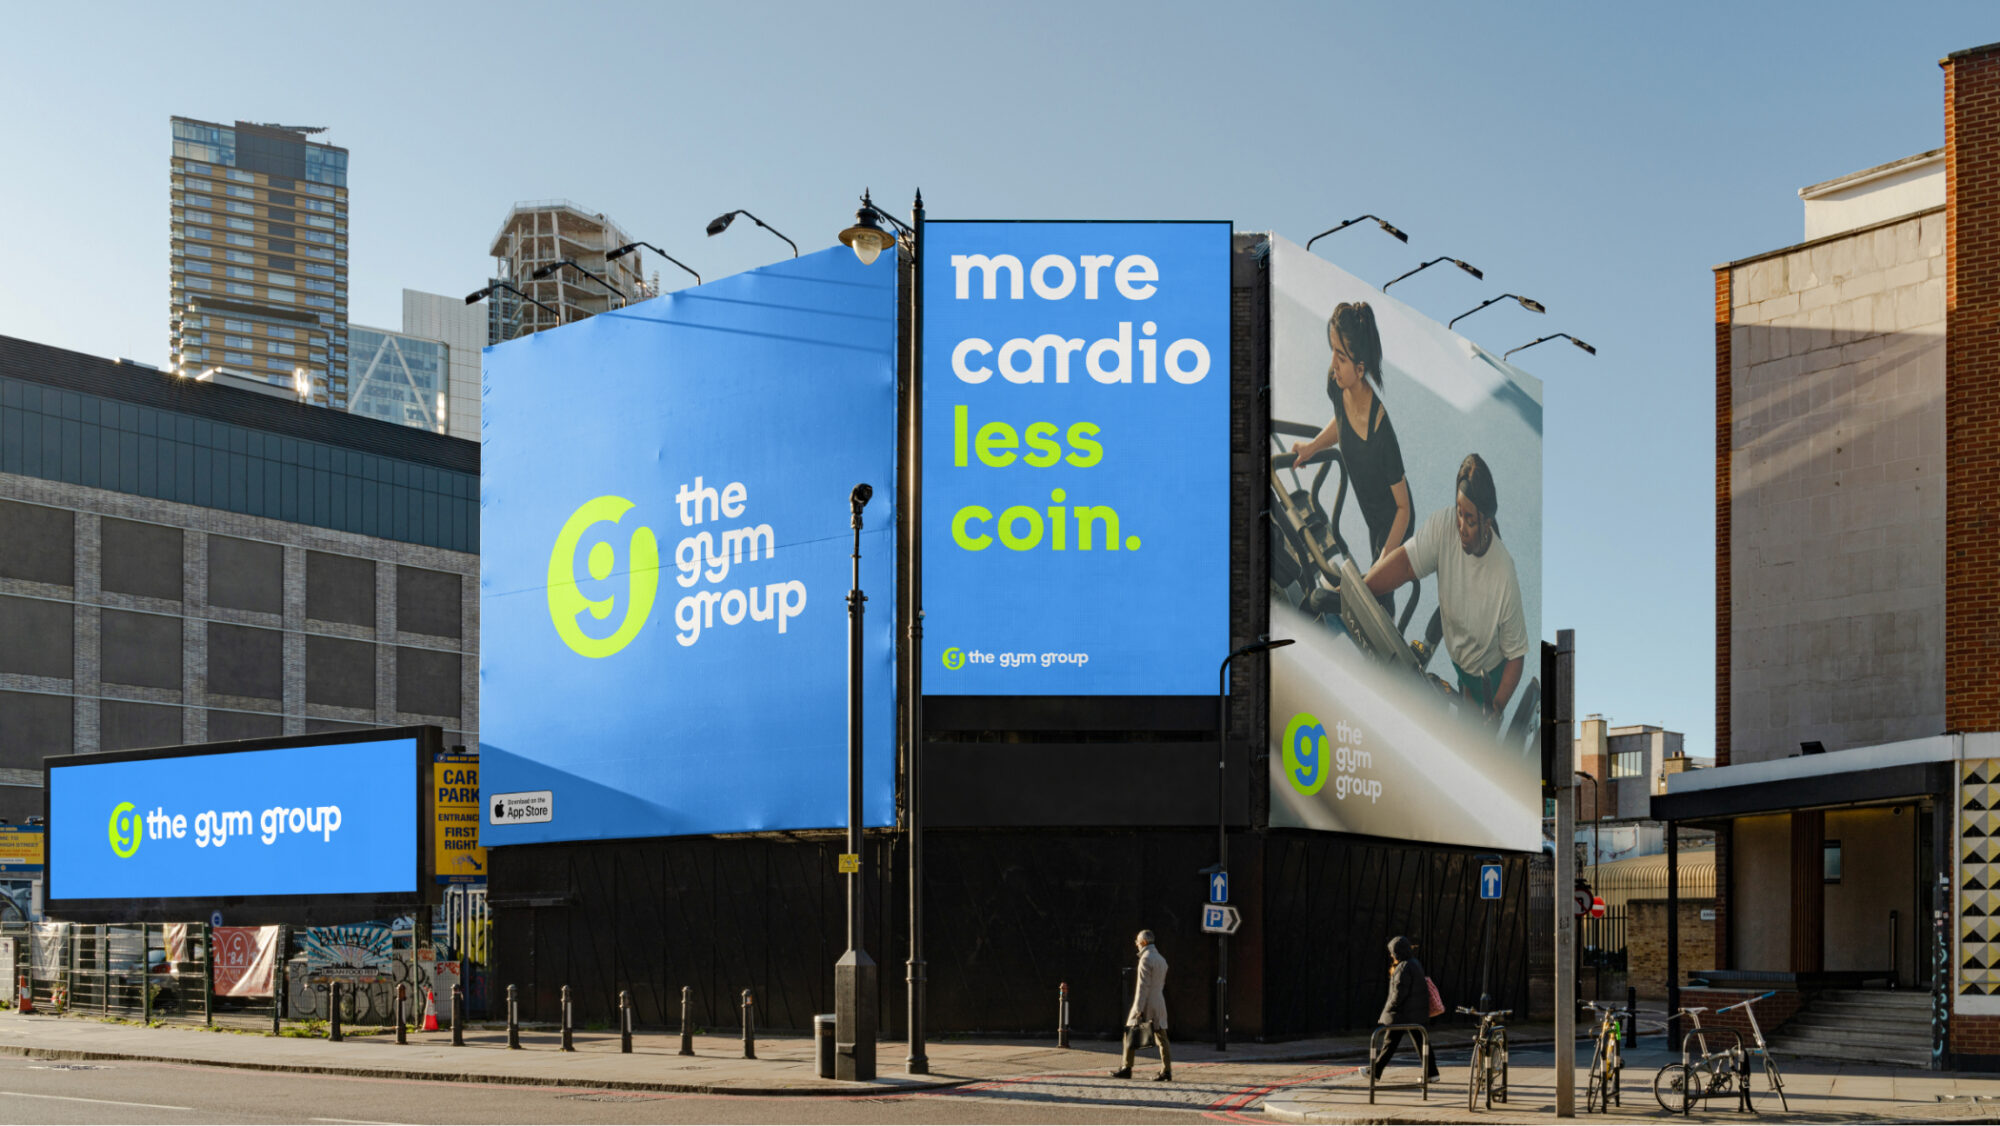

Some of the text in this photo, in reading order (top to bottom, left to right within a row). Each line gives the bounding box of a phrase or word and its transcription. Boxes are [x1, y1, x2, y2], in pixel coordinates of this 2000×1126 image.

[951, 254, 1159, 300] more
[952, 321, 1211, 384] cardio
[954, 405, 1103, 468] less
[675, 476, 748, 526] the
[951, 488, 1141, 551] coin.
[675, 523, 775, 588] gym
[675, 579, 807, 647] group
[968, 649, 995, 663] the
[999, 652, 1036, 667] gym
[1040, 652, 1089, 667] group
[1336, 720, 1363, 745] the
[1335, 747, 1372, 773] gym
[443, 769, 478, 785] CAR
[1335, 775, 1383, 804] group
[439, 788, 479, 803] PARK
[438, 813, 479, 822] ENTRANC
[507, 805, 548, 819] App Store
[147, 807, 188, 840] the
[195, 810, 253, 848] gym
[261, 806, 342, 846] group
[445, 827, 477, 837] FIRST
[444, 840, 478, 850] RIGHT
[1210, 911, 1221, 926] P
